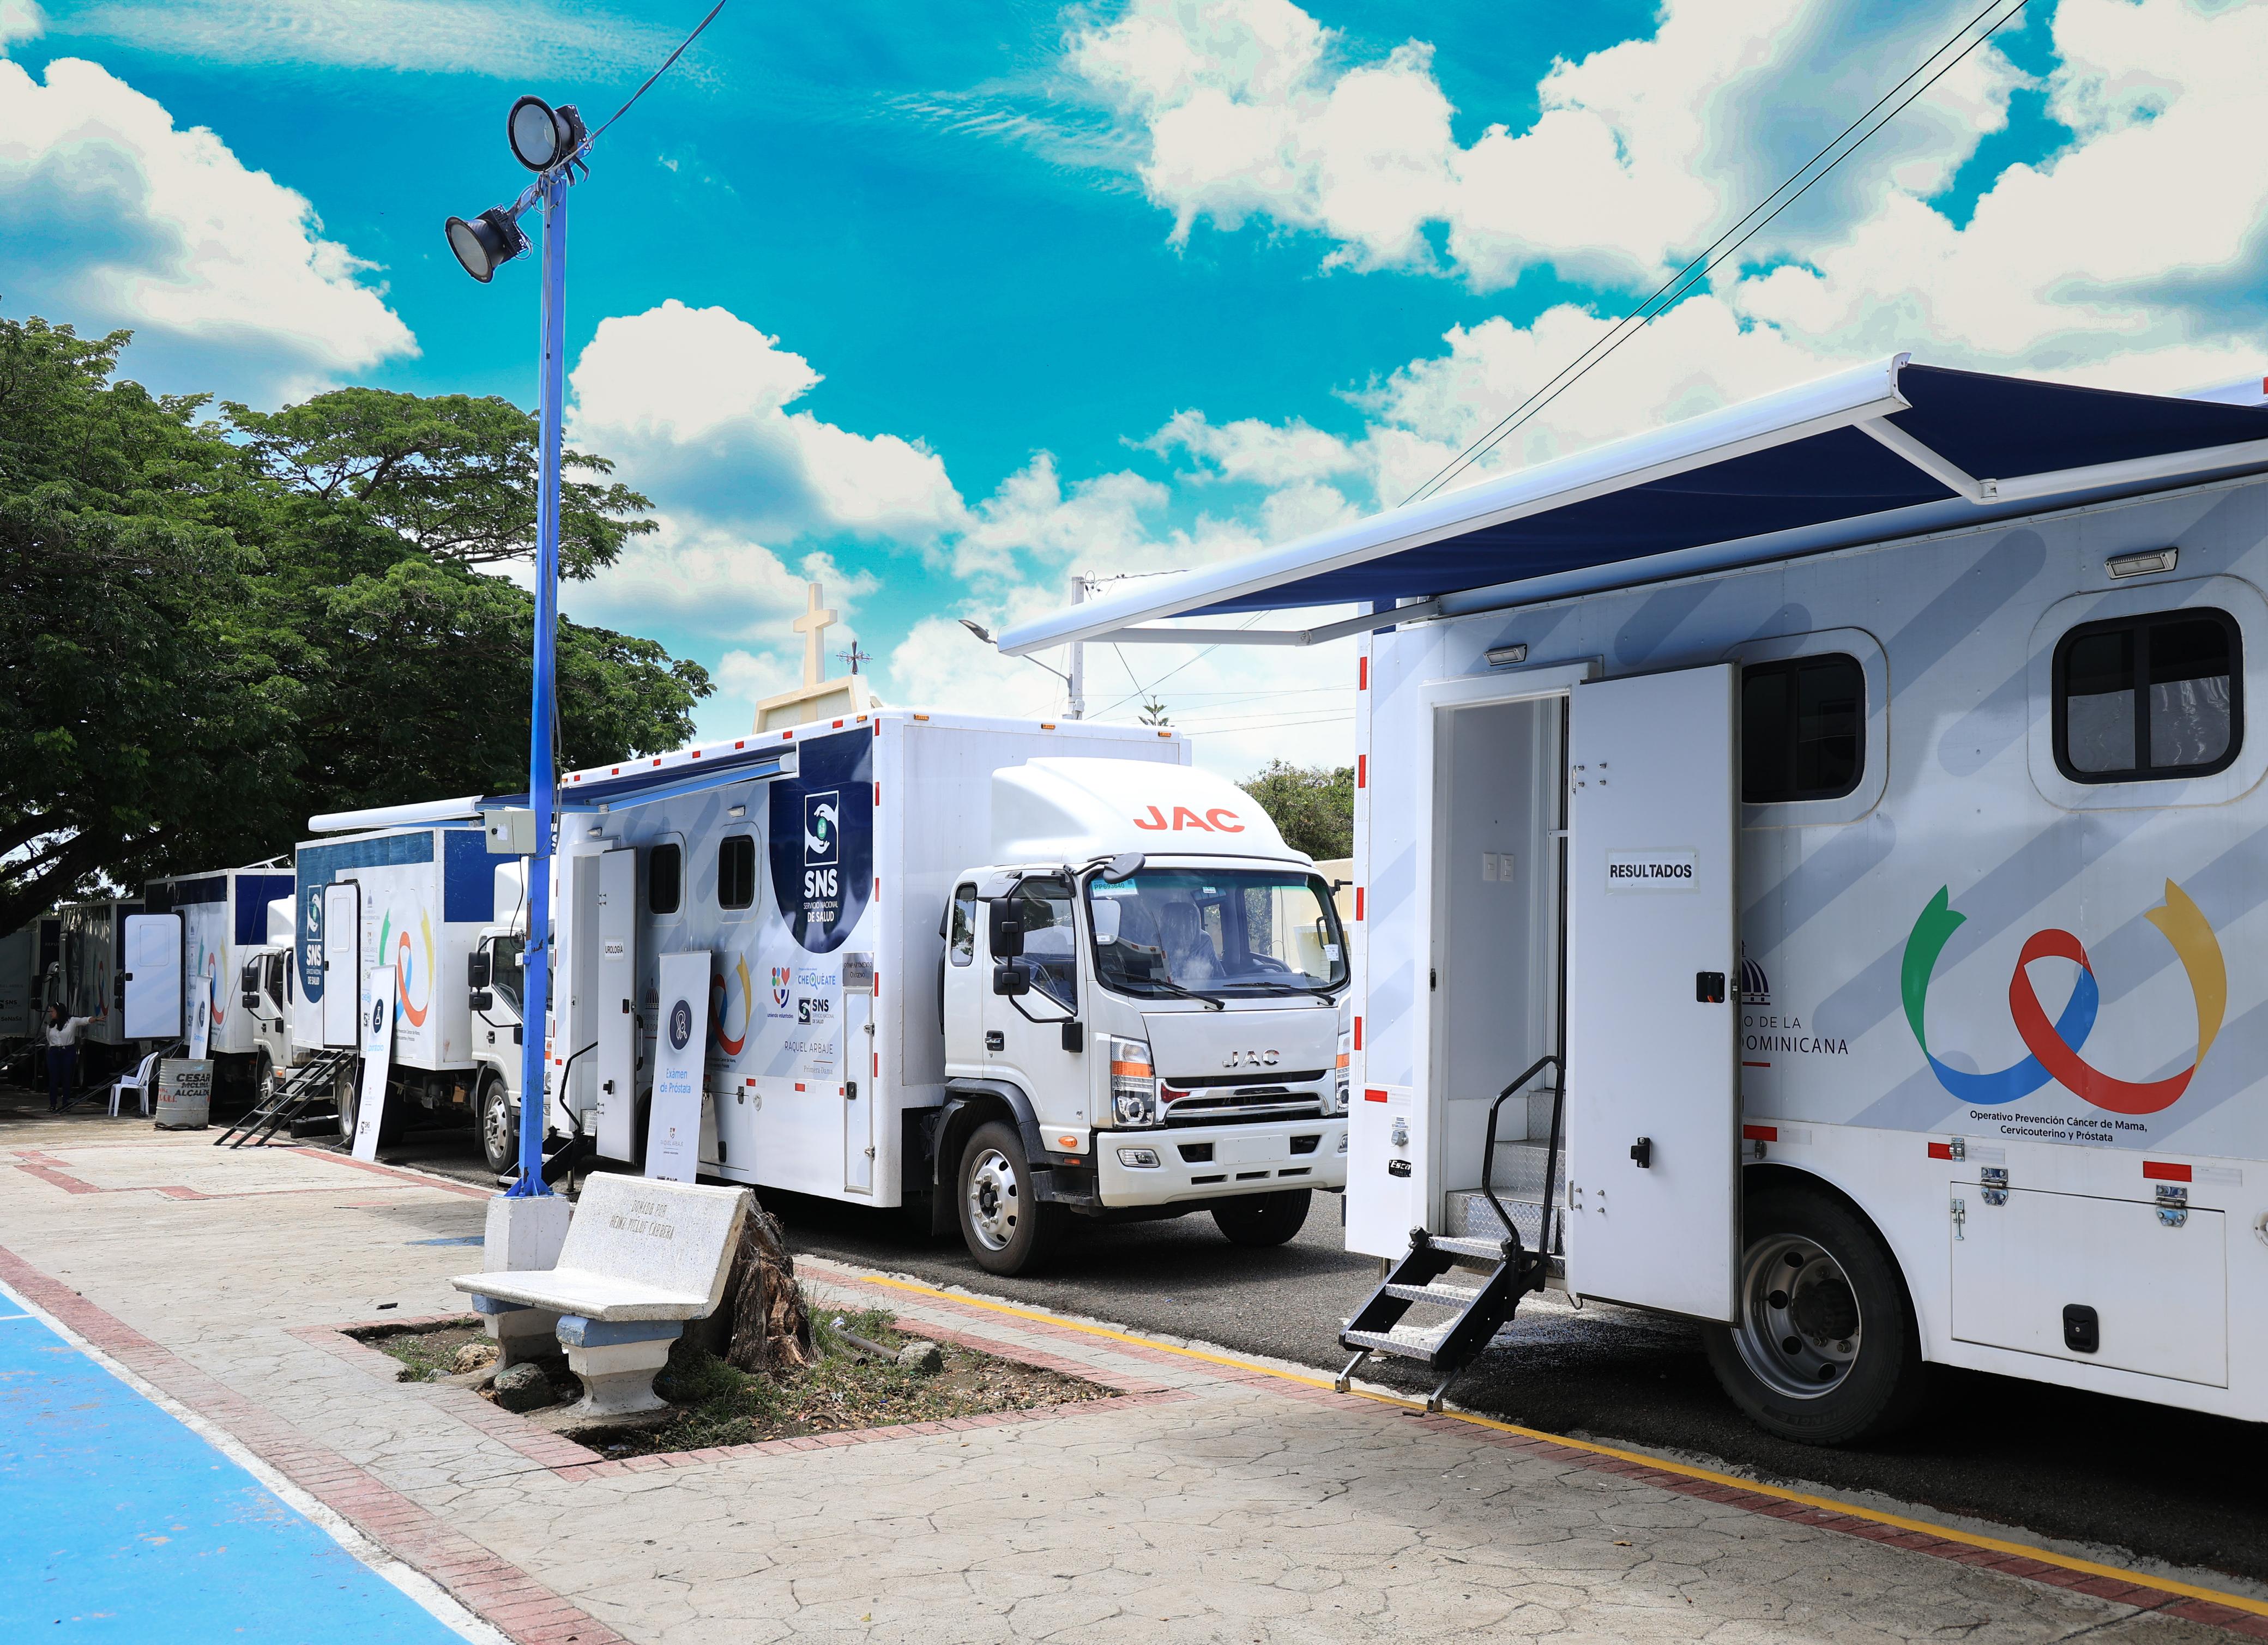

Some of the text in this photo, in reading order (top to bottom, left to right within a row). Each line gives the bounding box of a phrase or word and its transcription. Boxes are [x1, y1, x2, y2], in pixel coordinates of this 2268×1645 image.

[1133, 806, 1245, 833] JAC
[1610, 864, 1692, 878] RESULTADOS
[804, 868, 838, 898] SNS
[807, 911, 834, 922] DE SALUD
[306, 944, 322, 966] SNS
[812, 999, 829, 1012] SNS
[1760, 1016, 1777, 1028] DE
[1784, 1017, 1801, 1029] LA
[785, 1041, 833, 1054] RAQUEL ARBAJE
[1742, 1035, 1848, 1055] OMINICANA
[1222, 1048, 1280, 1068] JAC
[666, 1068, 687, 1079] Exámen
[804, 1065, 820, 1074] Primera
[176, 1073, 210, 1082] CESAR
[660, 1082, 691, 1093] de Próstata
[1970, 1110, 2148, 1133] Operativo Prevención Cáncer de Mama,
[2000, 1125, 2113, 1142] Cervicouterino y Próstata
[1390, 1160, 1411, 1170] Esca
